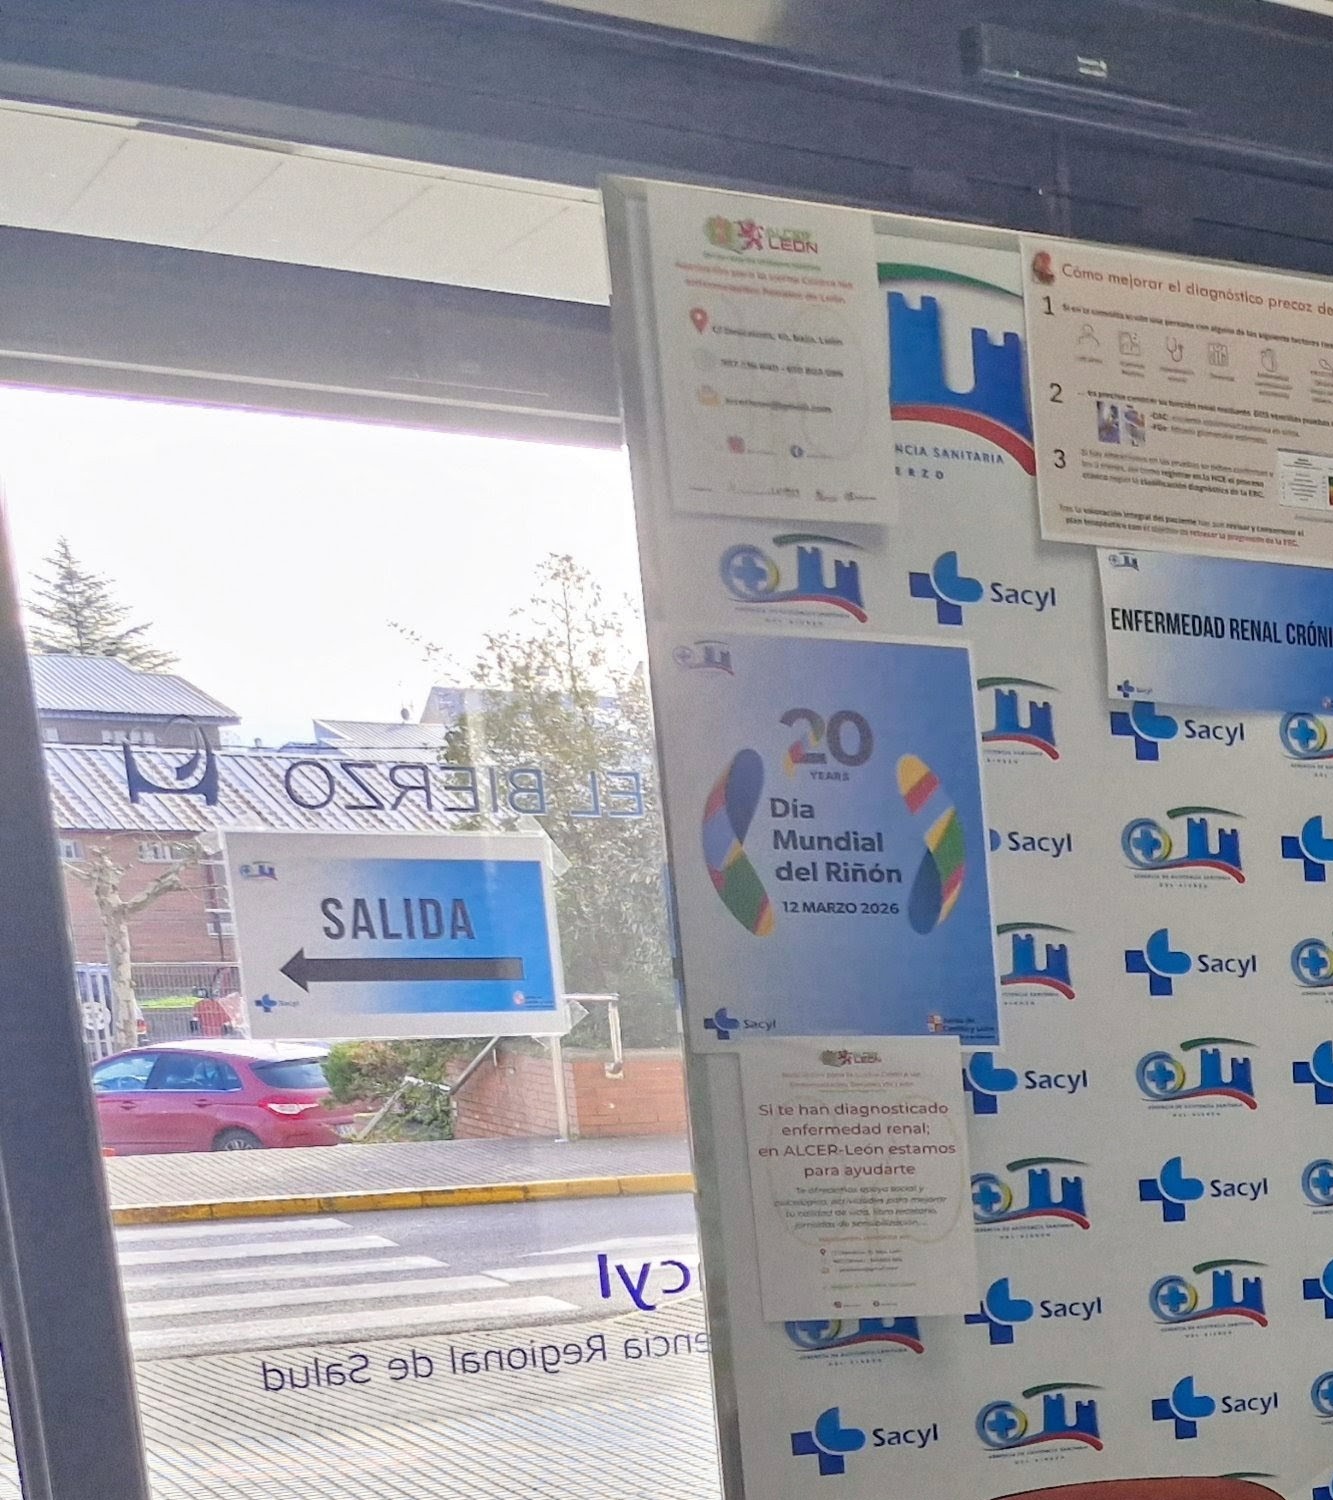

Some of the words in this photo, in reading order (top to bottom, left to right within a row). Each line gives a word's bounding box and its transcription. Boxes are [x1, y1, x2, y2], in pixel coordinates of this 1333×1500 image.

[1062, 263, 1103, 282] Cómo
[1108, 272, 1163, 291] mejorar
[1168, 279, 1181, 293] el
[1186, 282, 1264, 306] diagnóstico
[1268, 297, 1313, 313] precoz
[1318, 302, 1333, 316] de
[1042, 295, 1055, 316] 1
[1049, 382, 1064, 404] 2
[933, 447, 1005, 465] SANITARIA
[1052, 448, 1067, 469] 3
[989, 582, 1057, 611] Sacyl
[1110, 607, 1226, 640] ENFERMEDAD
[1229, 618, 1283, 645] RENAL
[779, 706, 875, 769] 20
[1183, 718, 1246, 747] Sacyl
[809, 770, 851, 782] YEARS
[769, 797, 816, 819] Día
[772, 829, 885, 853] Mundial
[1007, 829, 1074, 858] Sacyl
[774, 860, 819, 883] del
[826, 860, 903, 884] Riñón
[320, 896, 476, 941] SALIDA
[782, 901, 801, 914] 12
[801, 901, 858, 915] MARZO
[860, 902, 901, 915] 2026
[1197, 952, 1258, 980] Sacyl
[743, 1017, 777, 1031] Sacyl
[1023, 1067, 1089, 1094] Sacyl
[758, 1102, 774, 1116] Si
[777, 1103, 794, 1116] te
[798, 1103, 830, 1116] han
[833, 1102, 949, 1118] diagnosticado
[781, 1122, 882, 1137] enfermedad
[886, 1122, 931, 1136] renal;
[758, 1146, 779, 1158] en
[783, 1143, 884, 1158] ALCER-León
[888, 1143, 957, 1156] estamos
[803, 1166, 840, 1179] para
[843, 1163, 916, 1180] ayudarte
[1209, 1175, 1270, 1202] Sacyl
[1039, 1295, 1103, 1322] Sacyl
[1220, 1391, 1280, 1418] Sacyl
[871, 1421, 940, 1451] Sacyl
